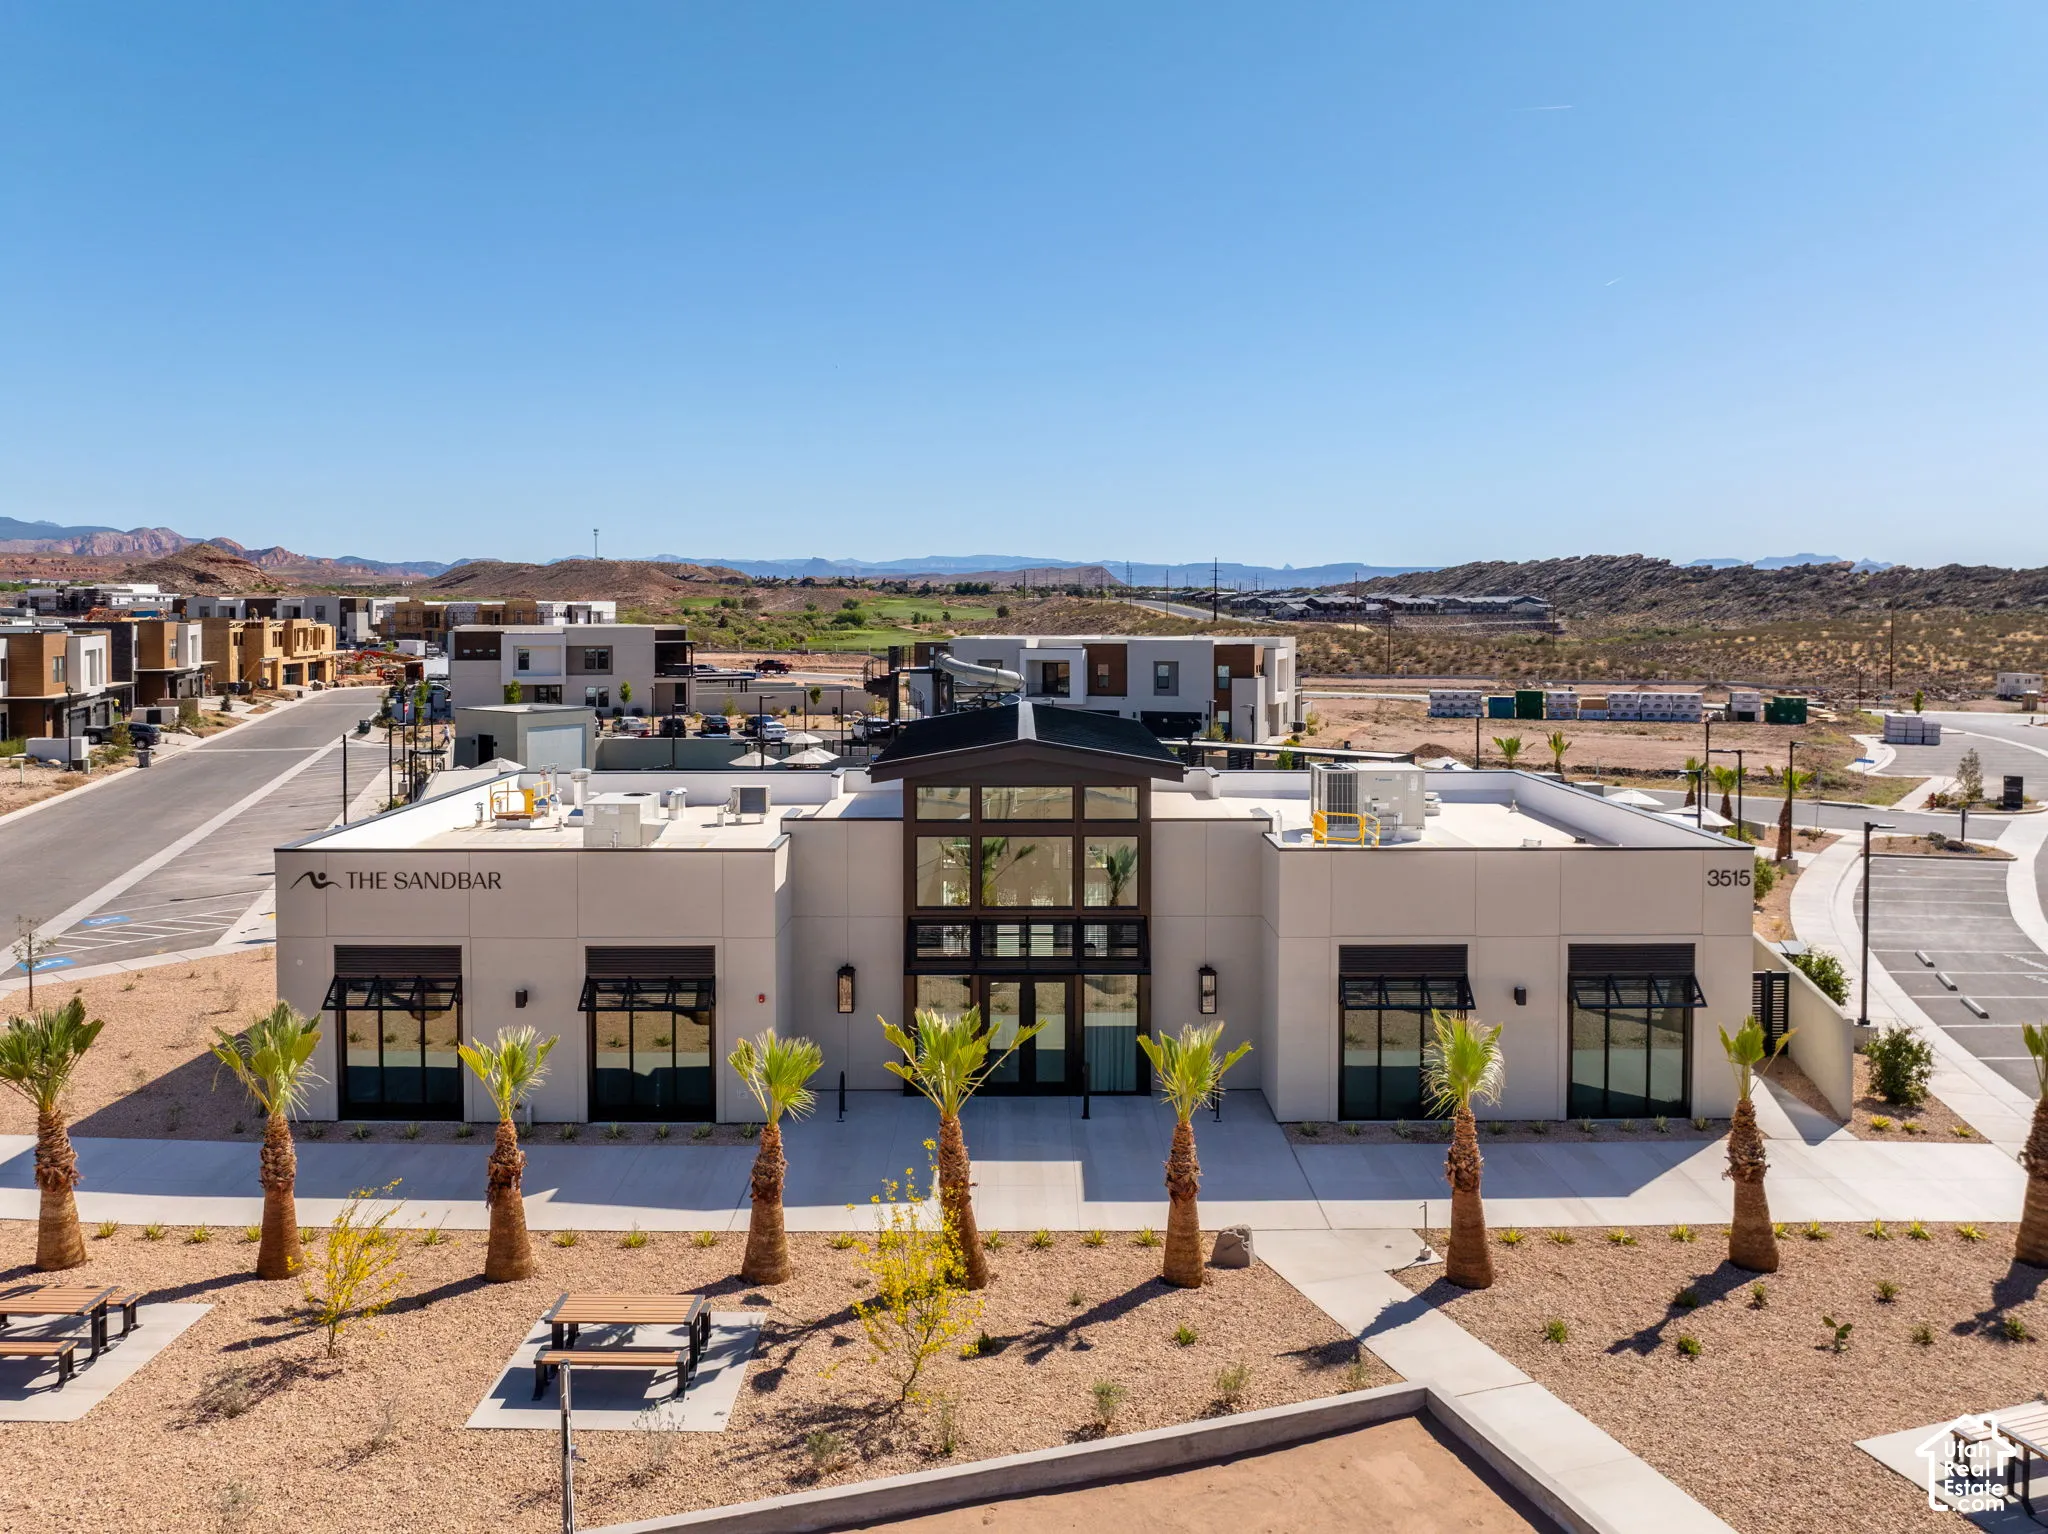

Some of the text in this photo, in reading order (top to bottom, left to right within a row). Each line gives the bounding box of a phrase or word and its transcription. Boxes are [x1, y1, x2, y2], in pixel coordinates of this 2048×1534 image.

[345, 871, 502, 890] THE SANDBAR
[1707, 869, 1751, 887] 3515
